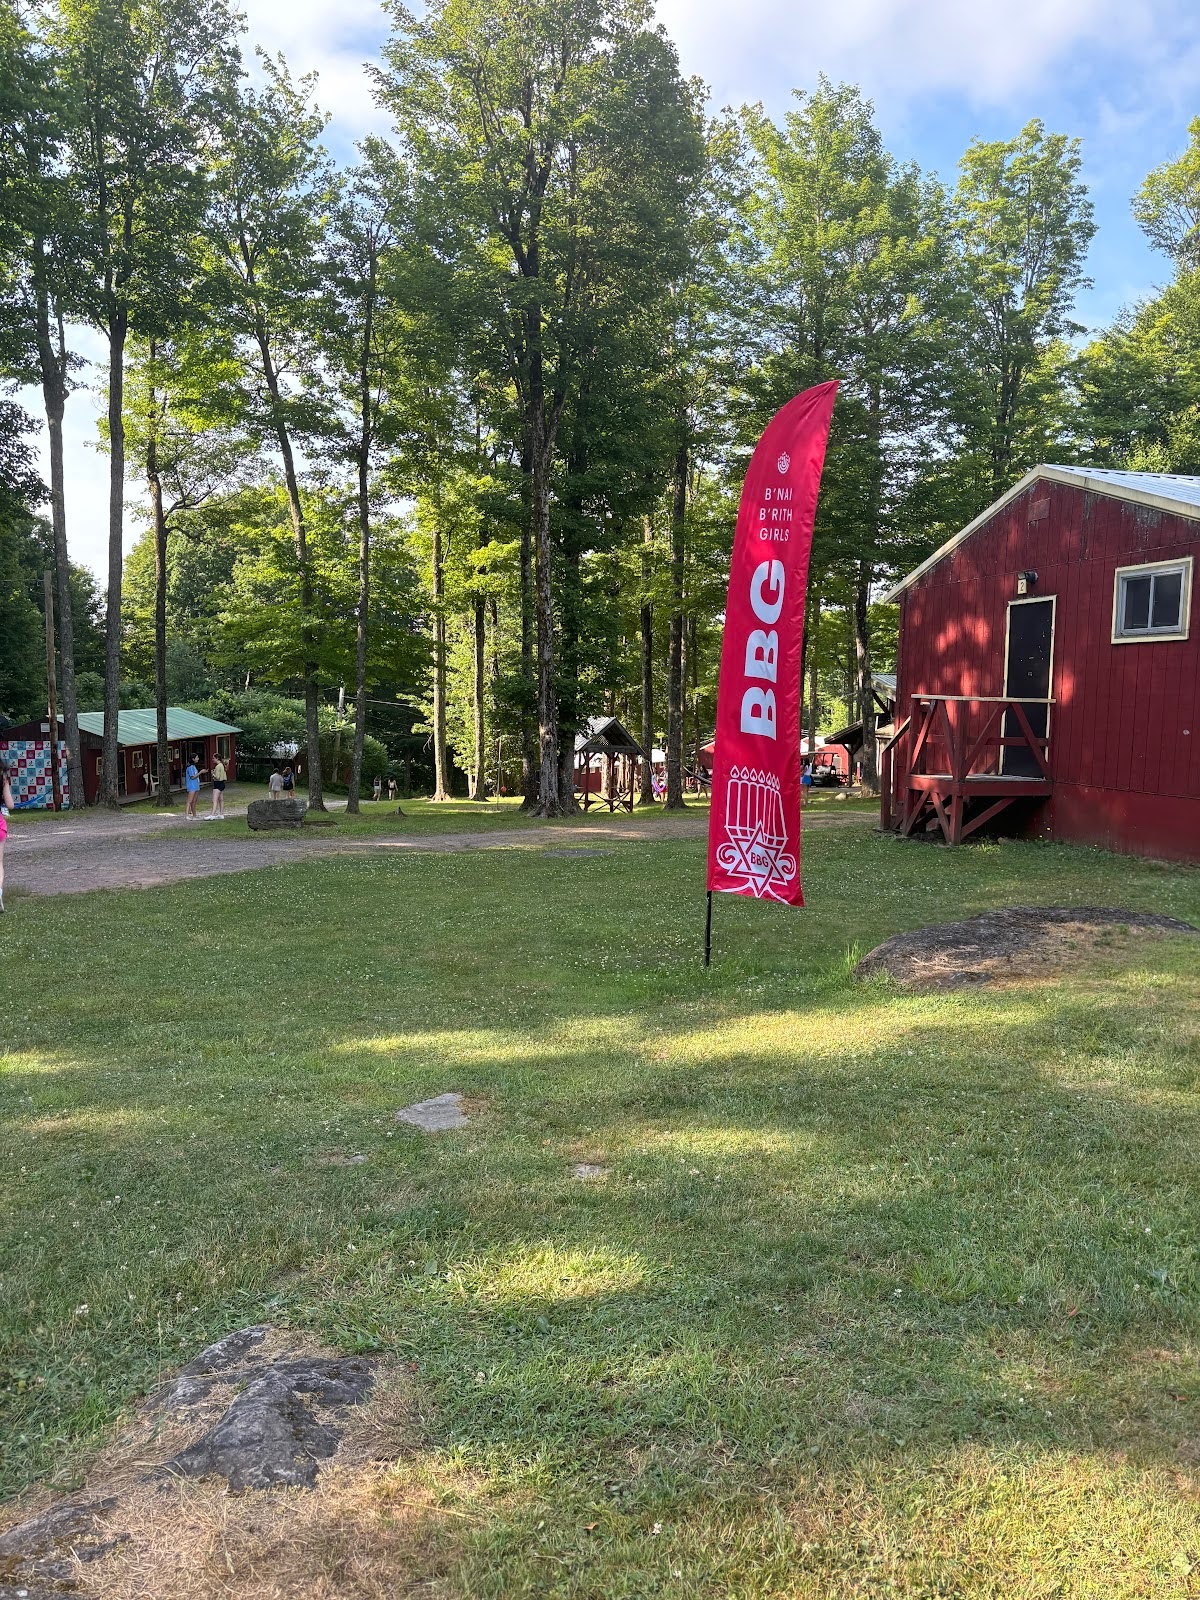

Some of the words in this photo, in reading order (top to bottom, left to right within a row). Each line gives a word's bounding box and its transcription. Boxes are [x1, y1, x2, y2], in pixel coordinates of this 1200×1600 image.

[765, 487, 793, 501] B'NAI
[759, 508, 793, 521] B'RITH
[759, 527, 790, 541] GIRLS
[740, 559, 786, 741] BBG
[750, 851, 769, 868] BBG
